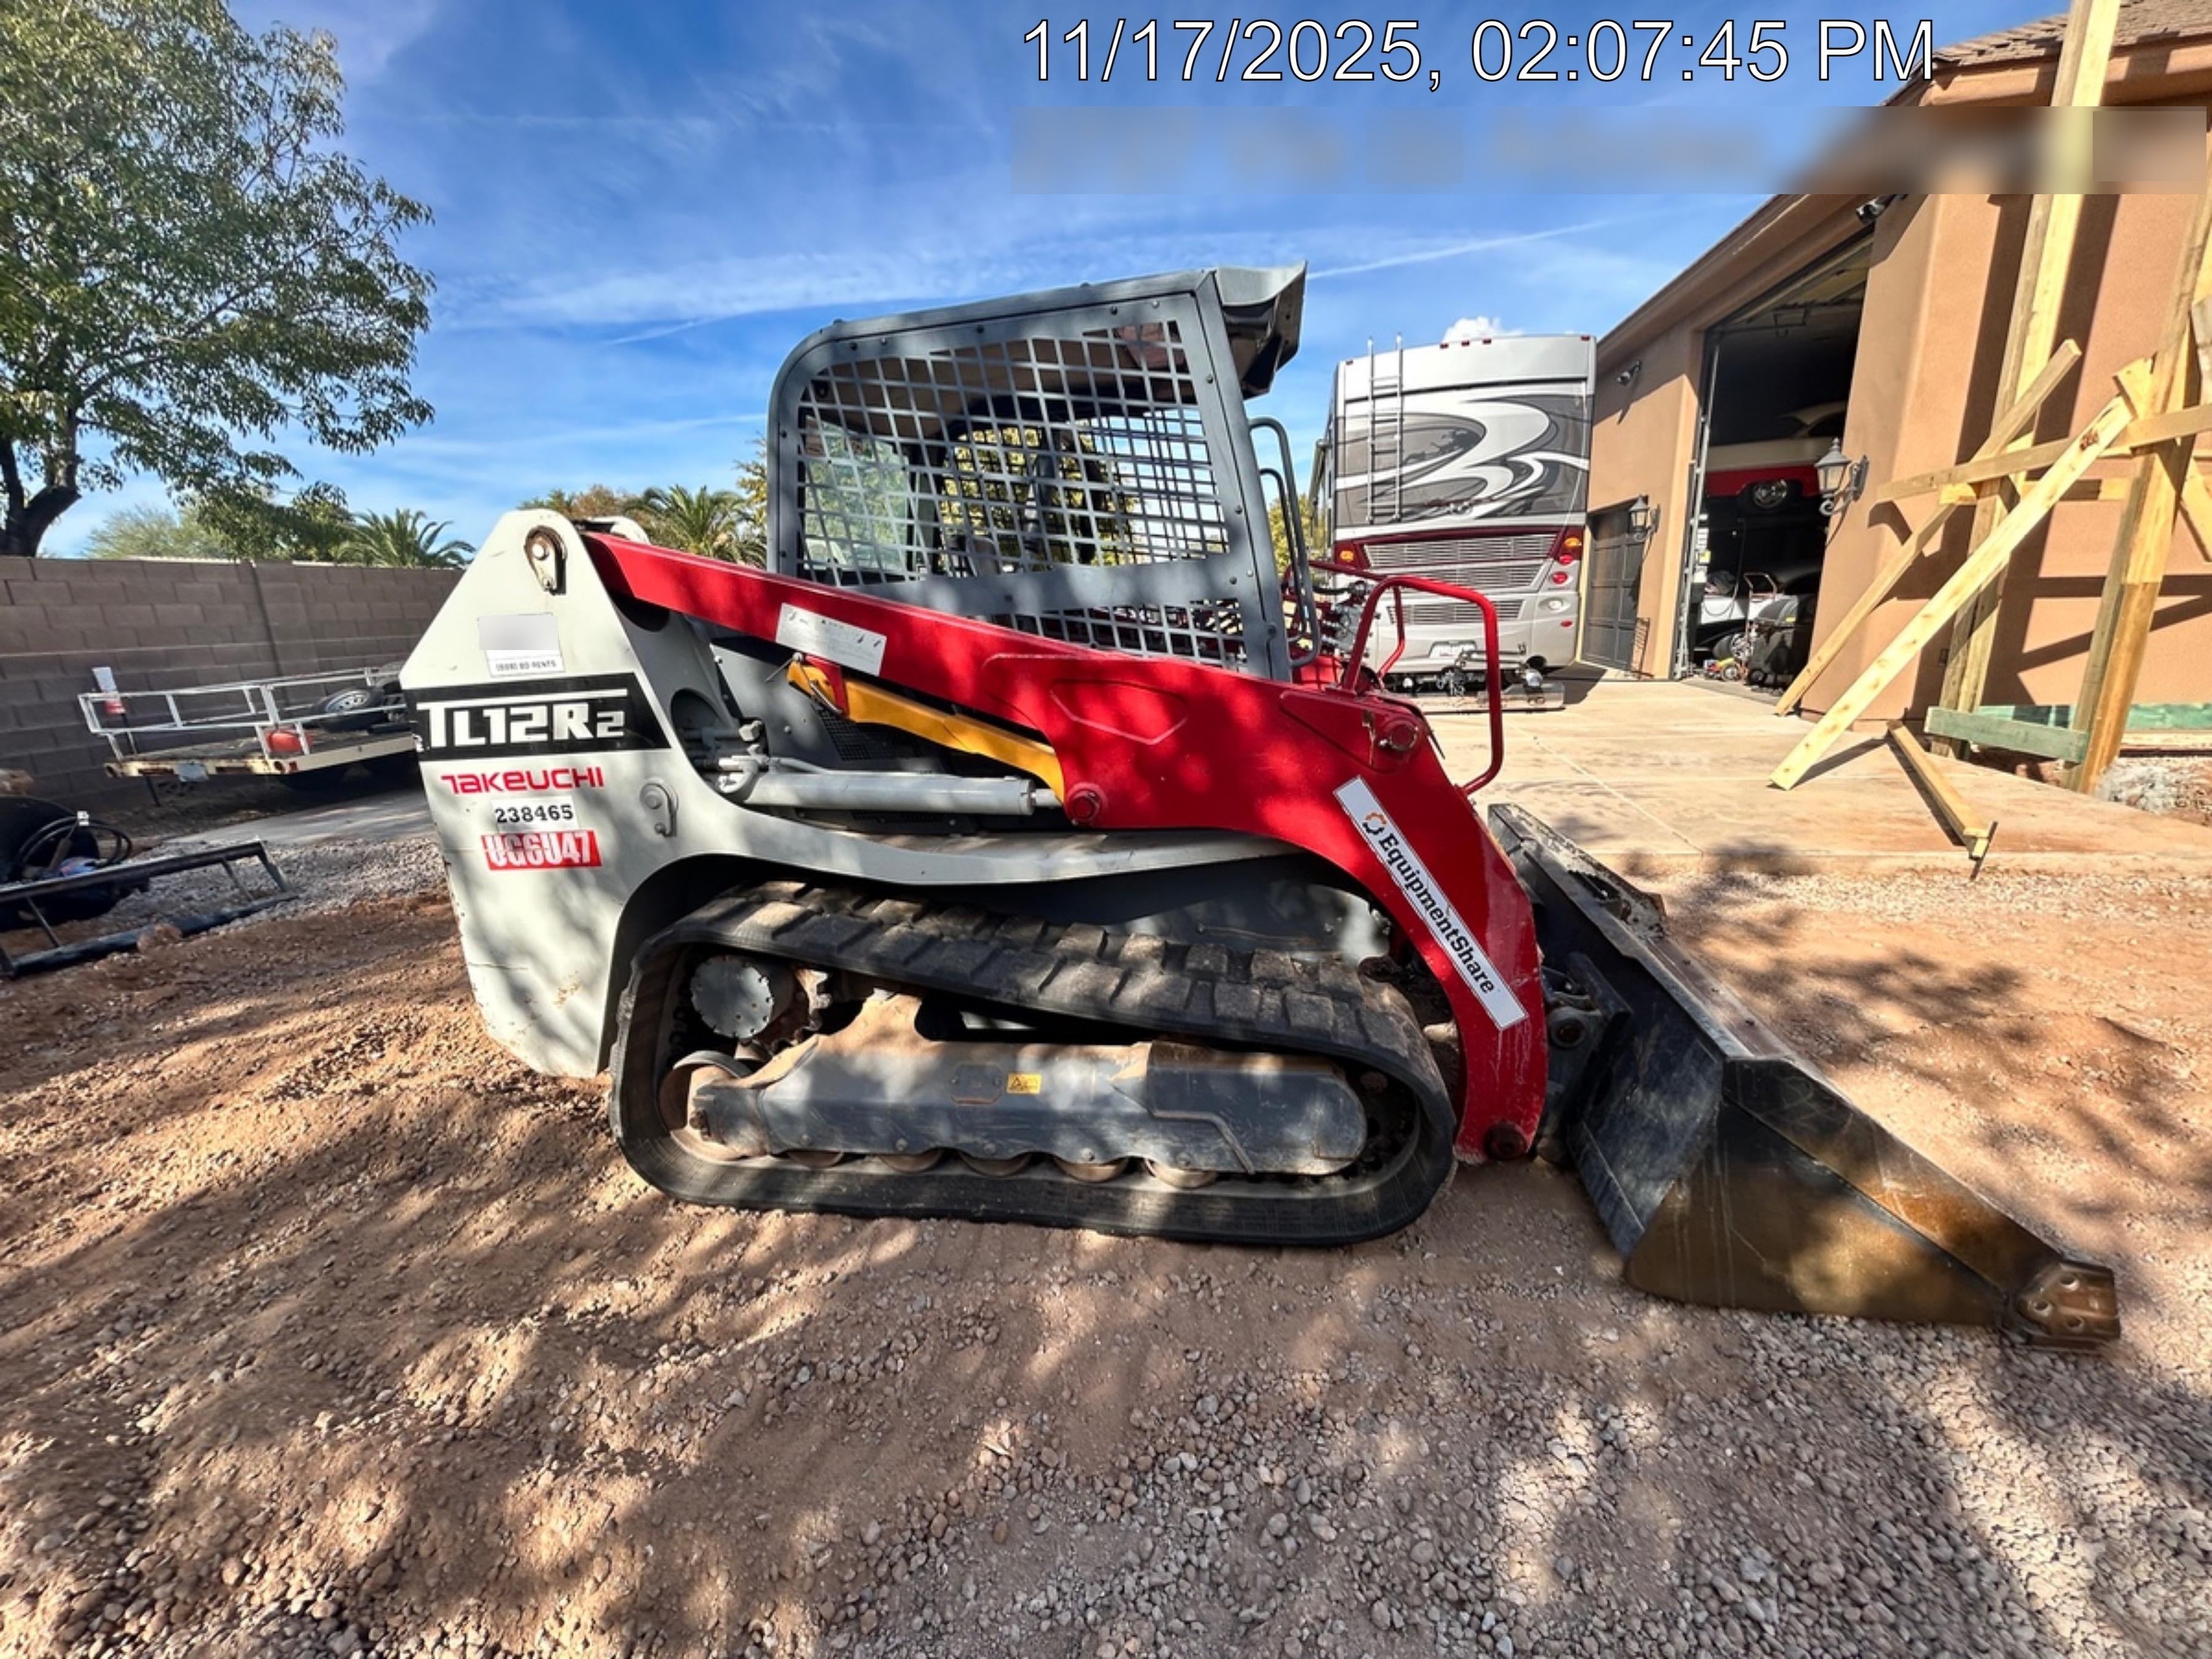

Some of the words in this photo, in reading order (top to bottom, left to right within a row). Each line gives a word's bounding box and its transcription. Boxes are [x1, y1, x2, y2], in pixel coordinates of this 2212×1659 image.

[441, 767, 603, 794] TAKEUCHI
[495, 805, 574, 823] 238465
[1379, 833, 1495, 994] EquipmentShare
